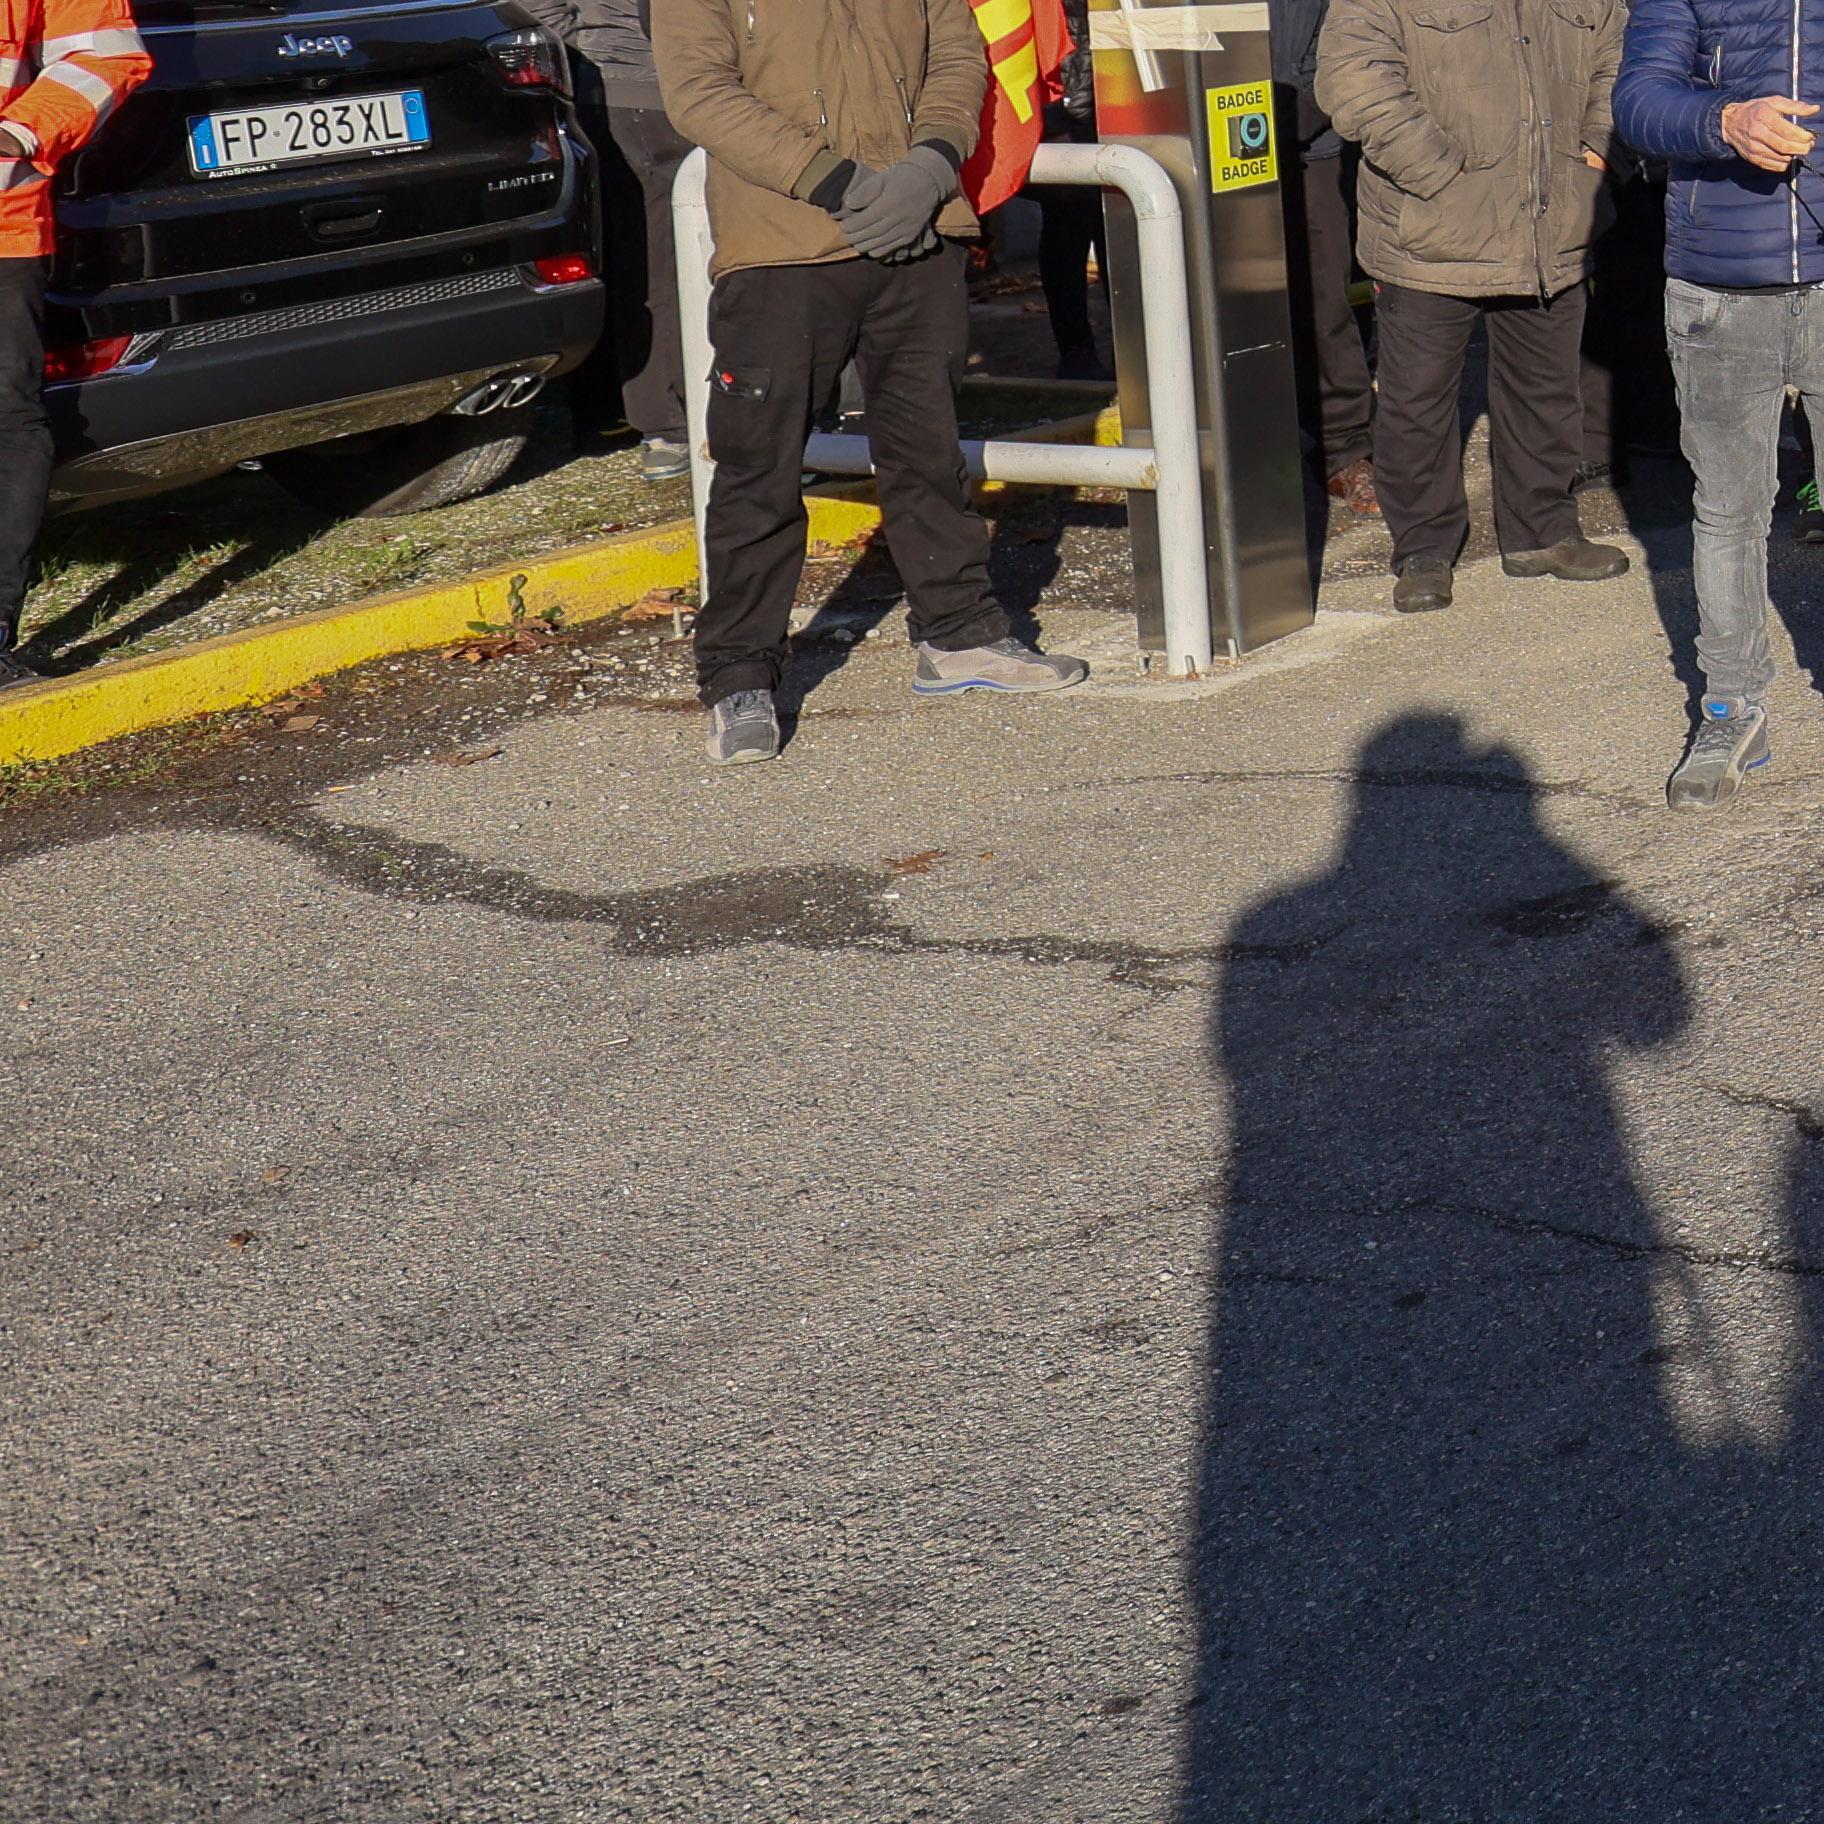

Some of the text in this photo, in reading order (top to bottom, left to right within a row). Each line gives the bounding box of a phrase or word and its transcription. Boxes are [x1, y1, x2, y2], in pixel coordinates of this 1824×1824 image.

[277, 33, 353, 59] Jeep
[1217, 90, 1263, 110] BADGE
[220, 101, 402, 161] FP 283XL
[1221, 159, 1268, 182] BADGE
